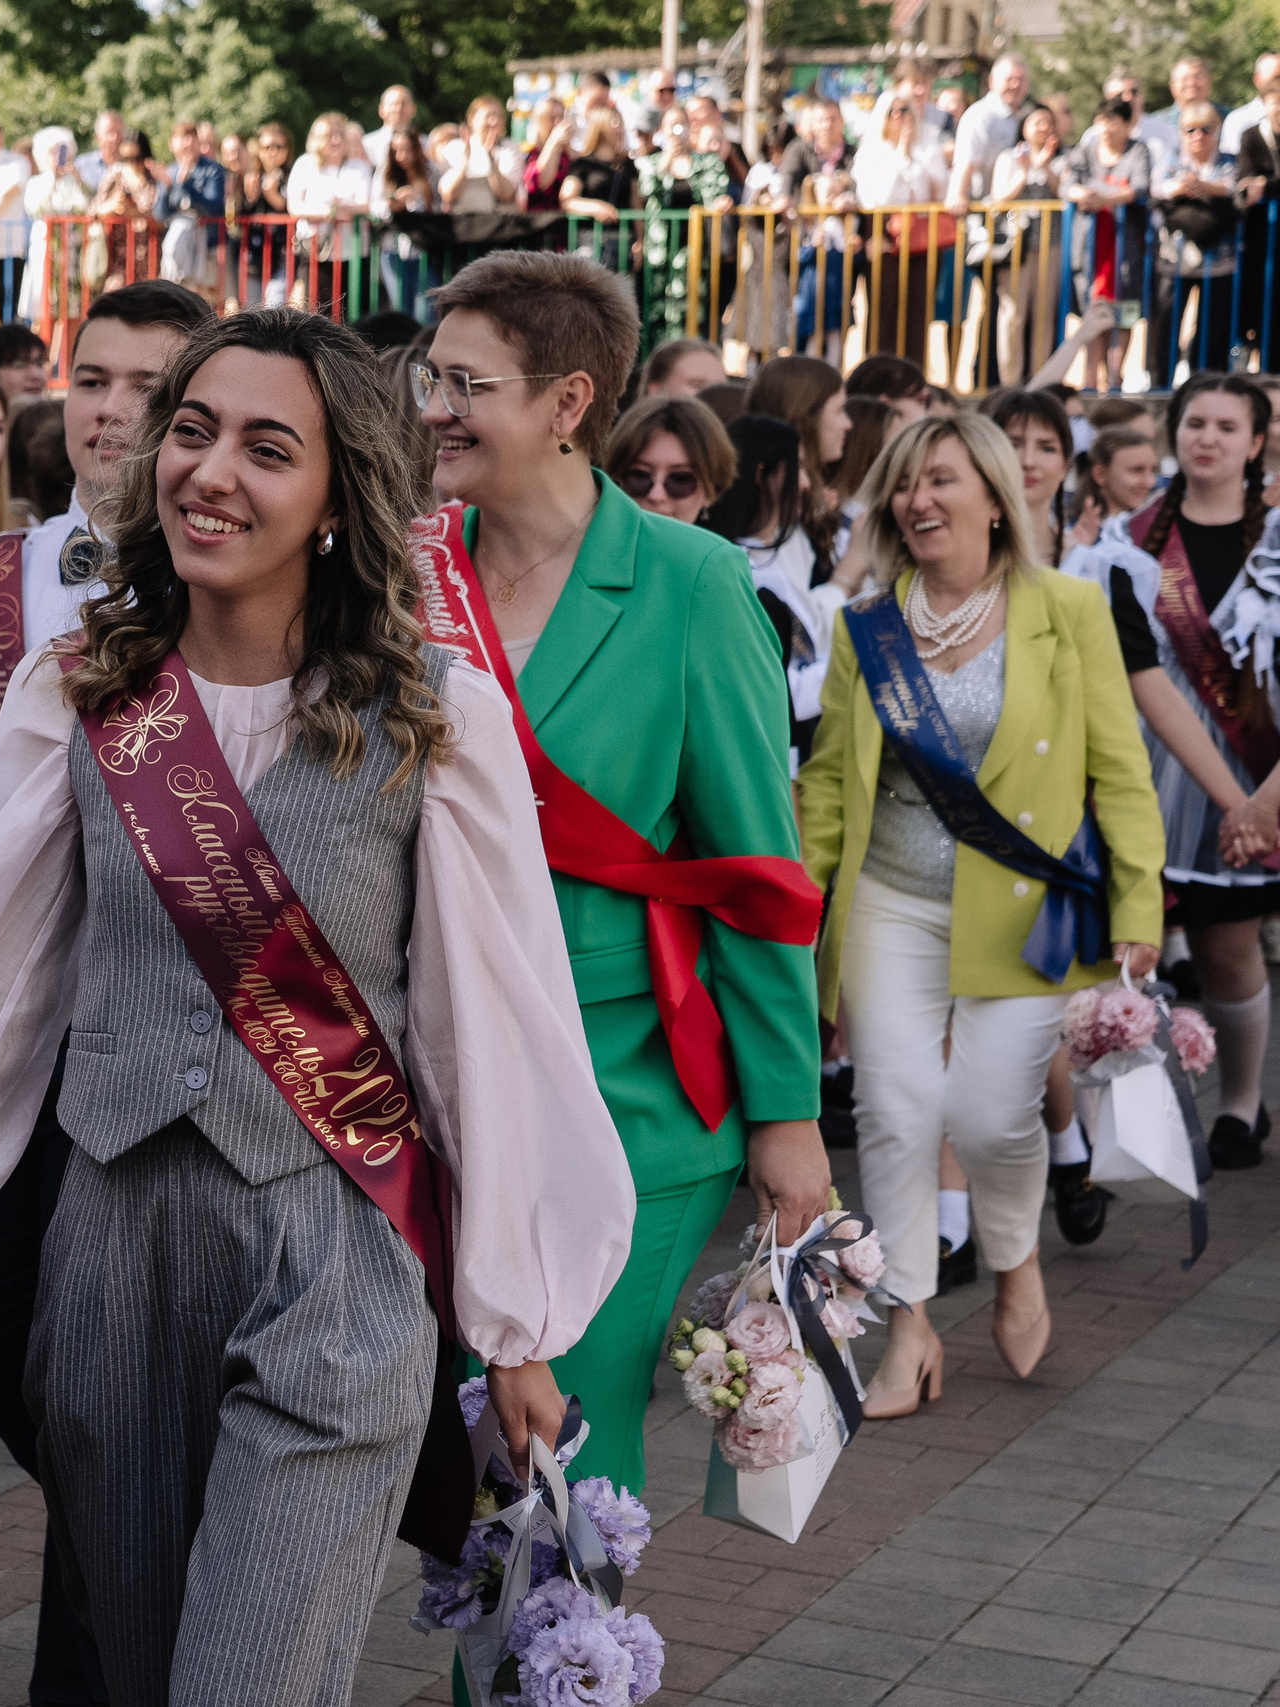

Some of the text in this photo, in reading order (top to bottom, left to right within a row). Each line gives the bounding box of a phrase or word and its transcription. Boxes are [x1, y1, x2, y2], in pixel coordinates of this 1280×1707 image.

[122, 801, 135, 813] 11
[140, 843, 162, 875] класс
[166, 764, 285, 940] Классный
[163, 876, 325, 1075] руководитель
[244, 847, 370, 1039] Кваша Татьяна Андреевна
[273, 1054, 320, 1111] СОШ
[309, 1047, 422, 1167] 2025
